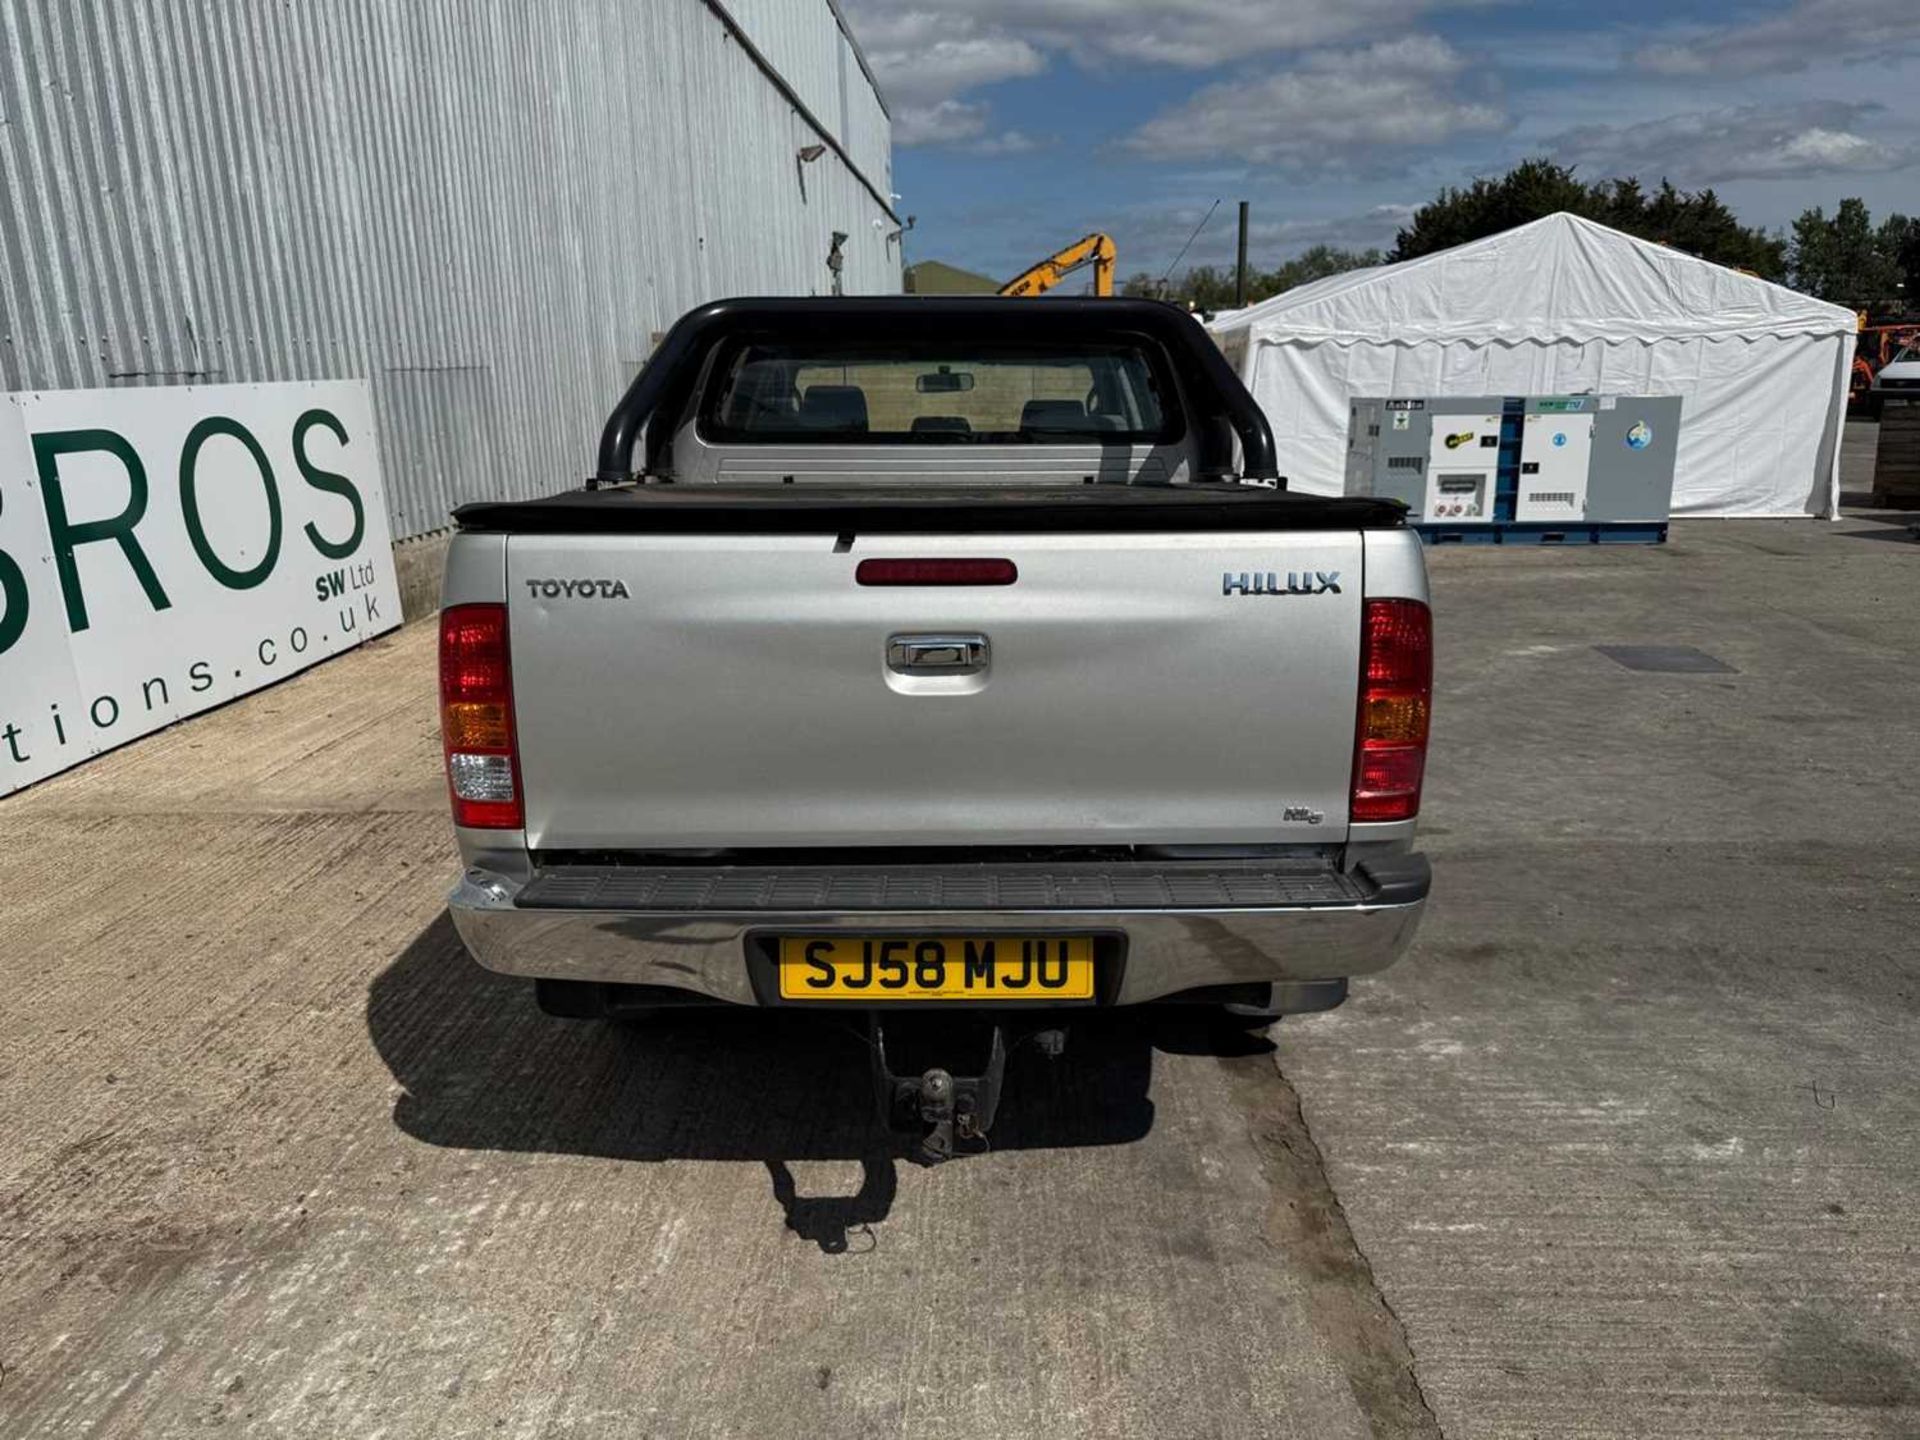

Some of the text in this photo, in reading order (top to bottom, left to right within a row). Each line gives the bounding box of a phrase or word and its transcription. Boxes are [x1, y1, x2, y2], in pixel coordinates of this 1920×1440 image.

[0, 409, 365, 655] ROS
[315, 558, 375, 601] SW Ltd
[525, 579, 630, 599] TOYOTA
[1222, 572, 1342, 595] HILUX
[805, 940, 1069, 989] SJ58 MJU
